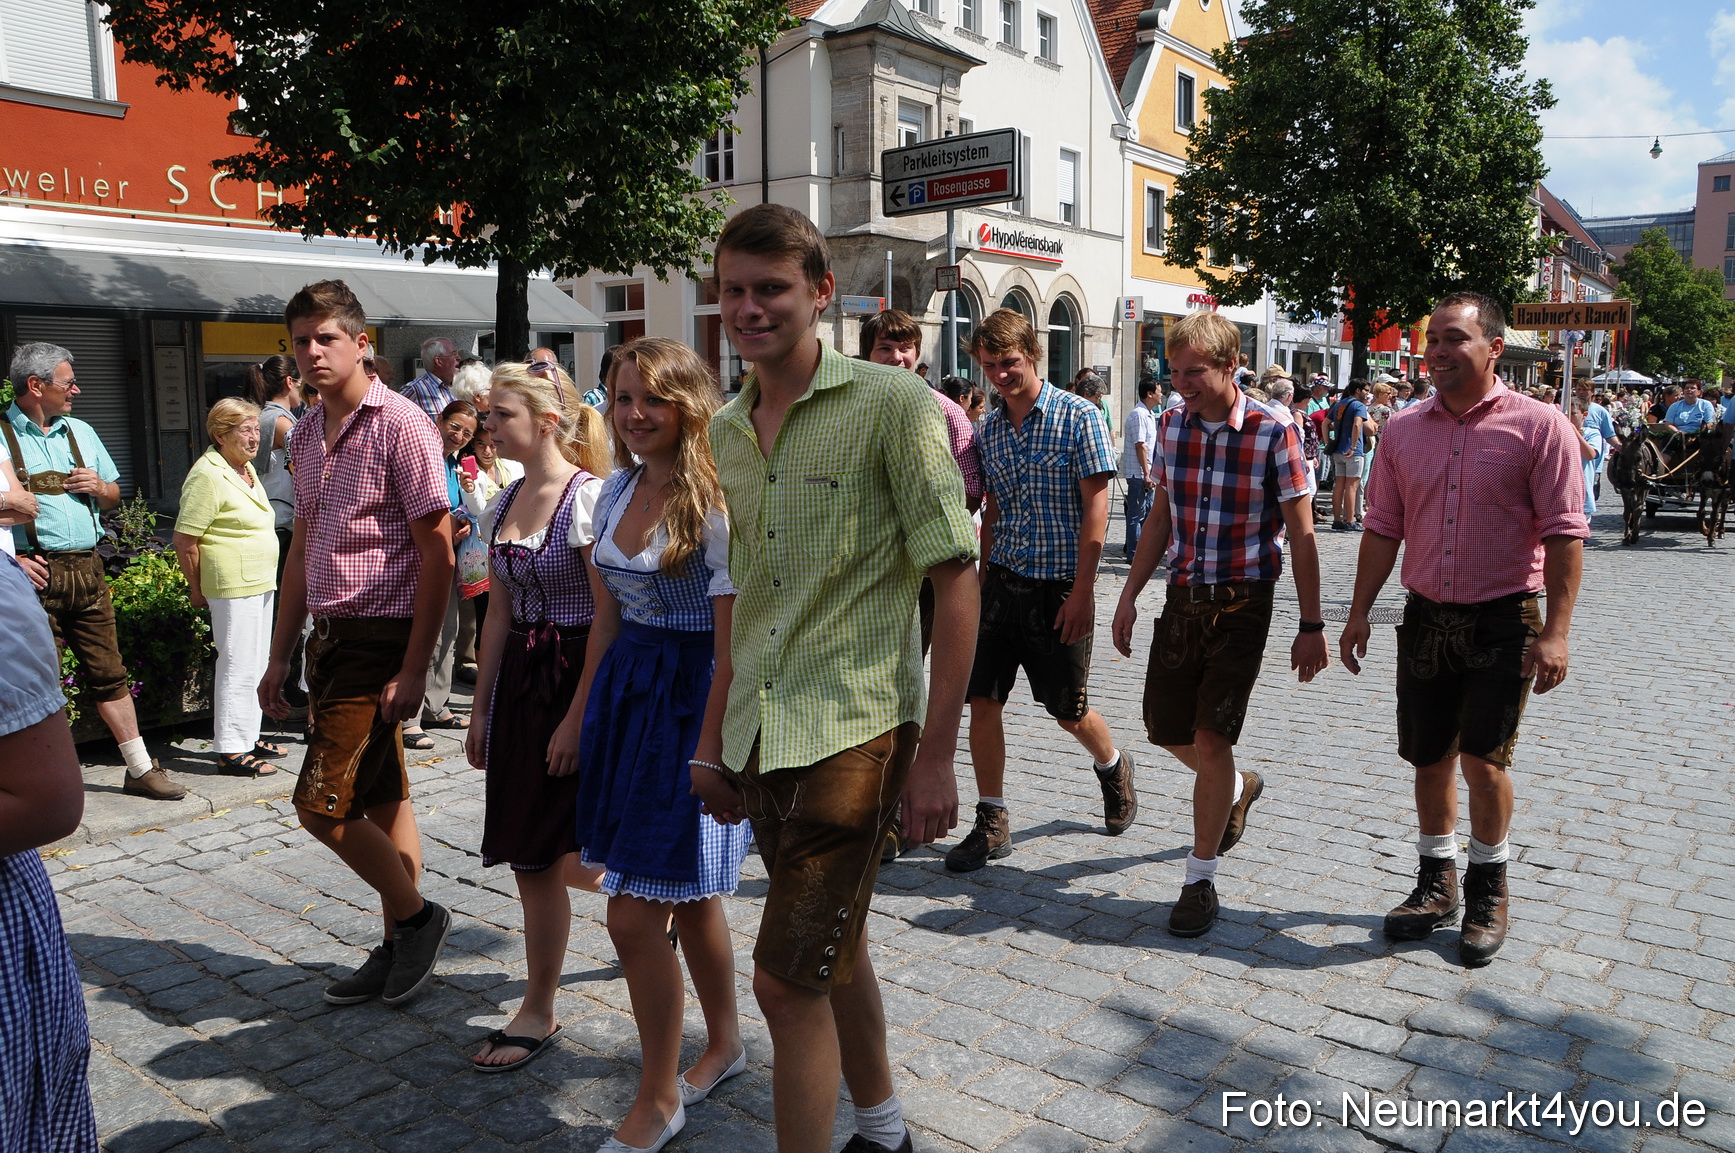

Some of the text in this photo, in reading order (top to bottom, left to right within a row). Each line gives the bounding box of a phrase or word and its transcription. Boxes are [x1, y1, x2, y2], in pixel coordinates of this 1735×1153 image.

[903, 145, 989, 172] Parkleitsystem
[933, 177, 991, 196] Rosengasse
[991, 226, 1064, 254] HypoVereinsbank
[1517, 306, 1627, 325] Haubner's Ranch
